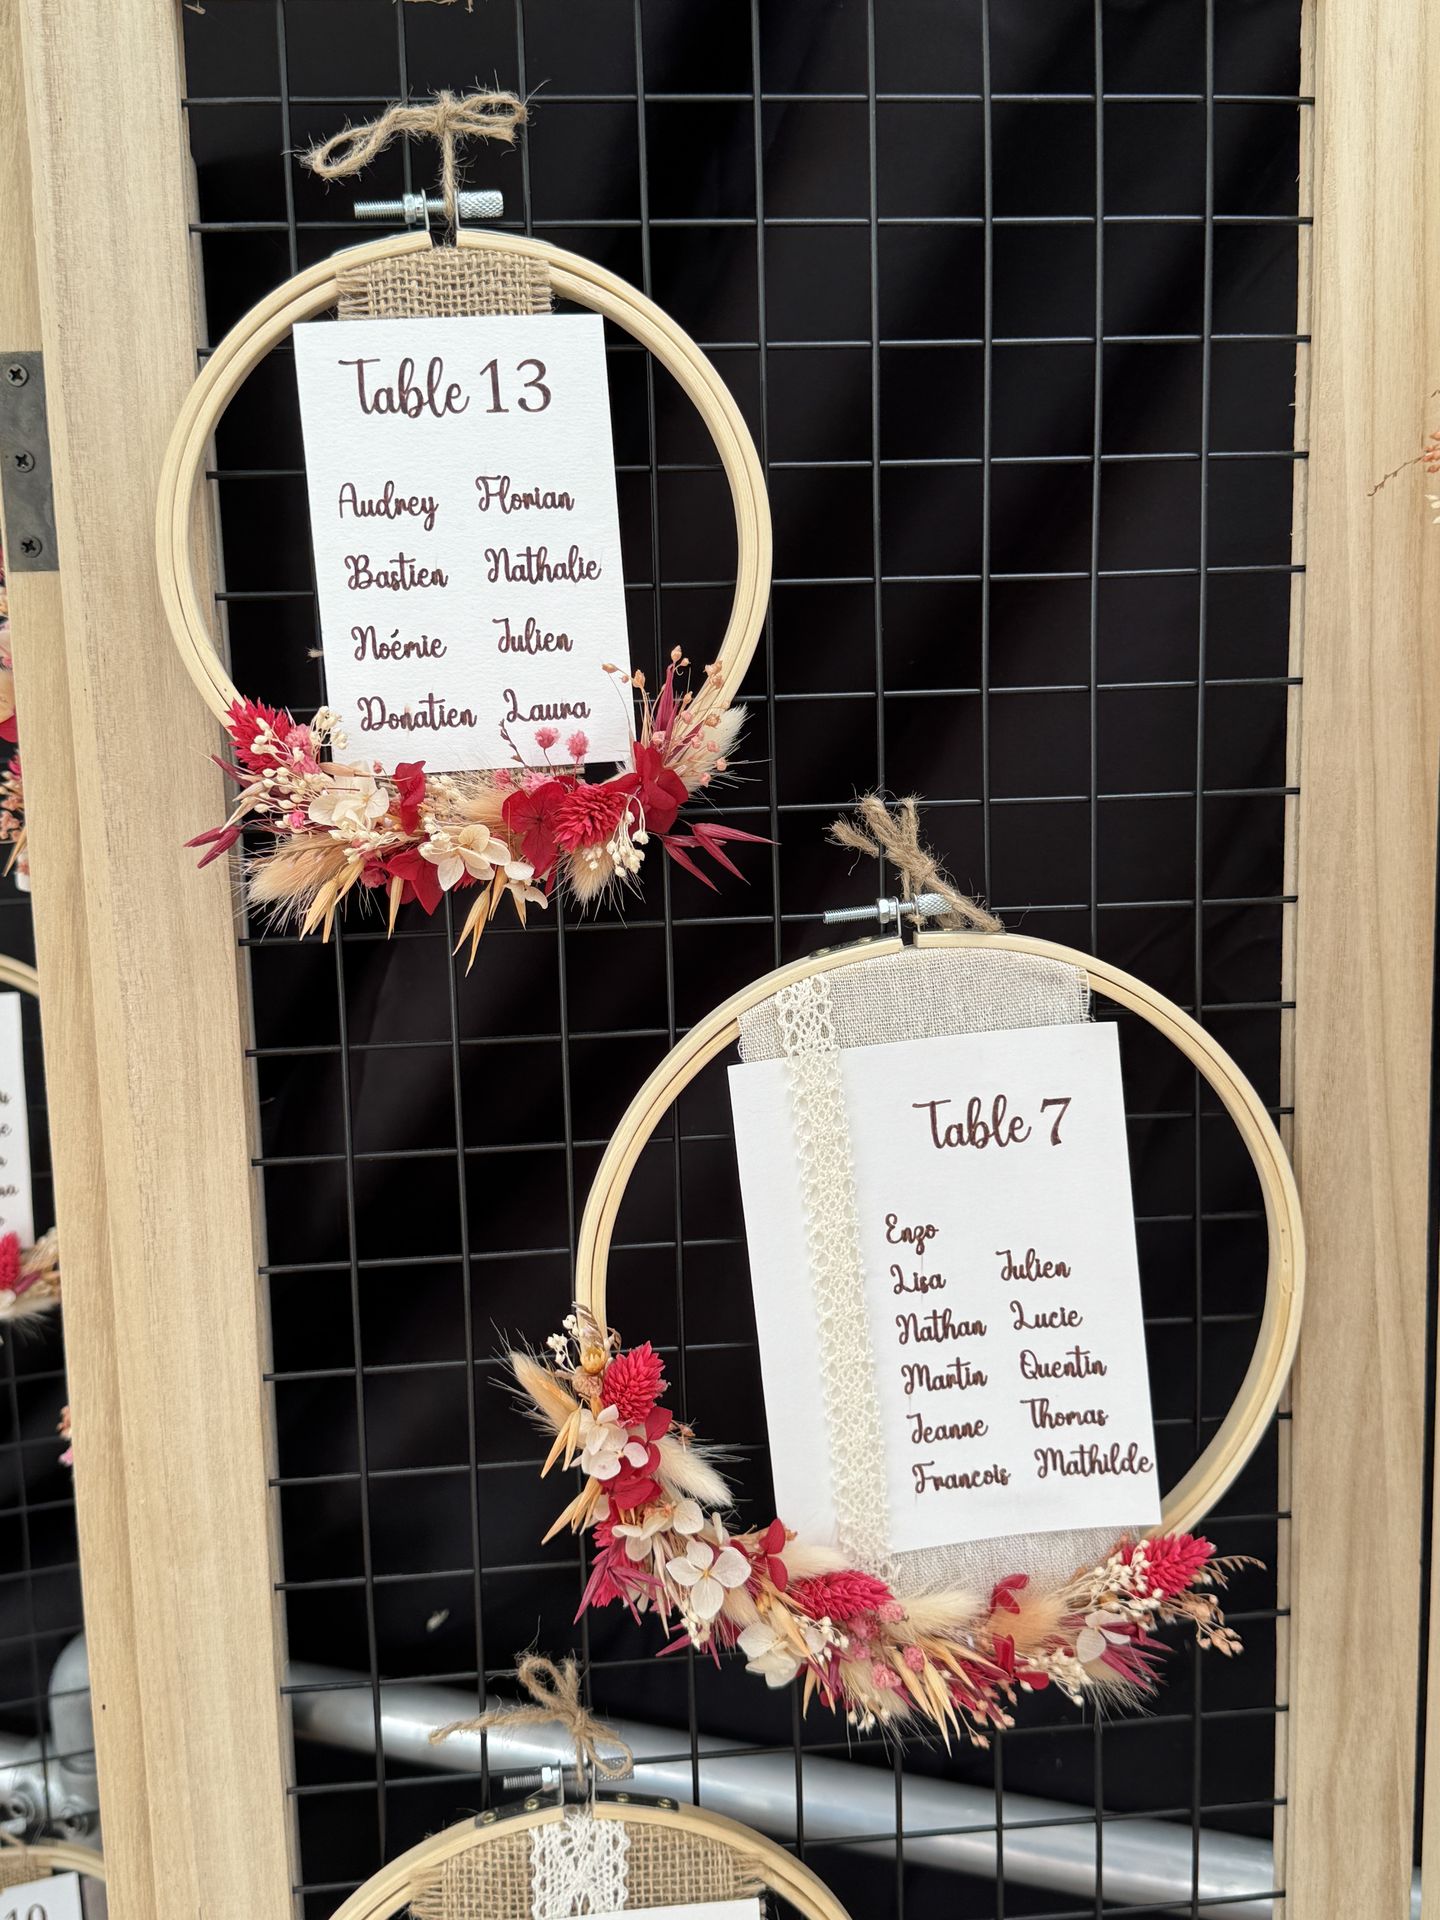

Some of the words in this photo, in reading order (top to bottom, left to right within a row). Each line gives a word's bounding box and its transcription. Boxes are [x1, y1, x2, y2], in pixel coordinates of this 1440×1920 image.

[337, 356, 470, 419] Table
[479, 358, 552, 414] 13
[338, 480, 440, 532] Audrey
[475, 474, 575, 515] Florian
[344, 551, 449, 592] Bastien
[484, 544, 602, 585] Nathalie
[350, 625, 448, 662] Noémie
[491, 616, 574, 656] Julien
[356, 692, 478, 732] Donatien
[501, 688, 592, 724] Laura
[911, 1094, 1032, 1150] Table
[1040, 1097, 1072, 1147] 7
[885, 1213, 940, 1256] Enzo
[889, 1263, 947, 1295] Lisa
[995, 1247, 1072, 1282] Julien
[895, 1307, 988, 1346] Nathan
[1009, 1300, 1084, 1331] Lucie
[900, 1356, 988, 1396] Martin
[1019, 1345, 1108, 1380] Quentin
[905, 1412, 989, 1445] Jeanne
[1019, 1397, 1109, 1430] Thomas
[911, 1460, 1012, 1494] Francois
[1033, 1441, 1154, 1479] Mathilde
